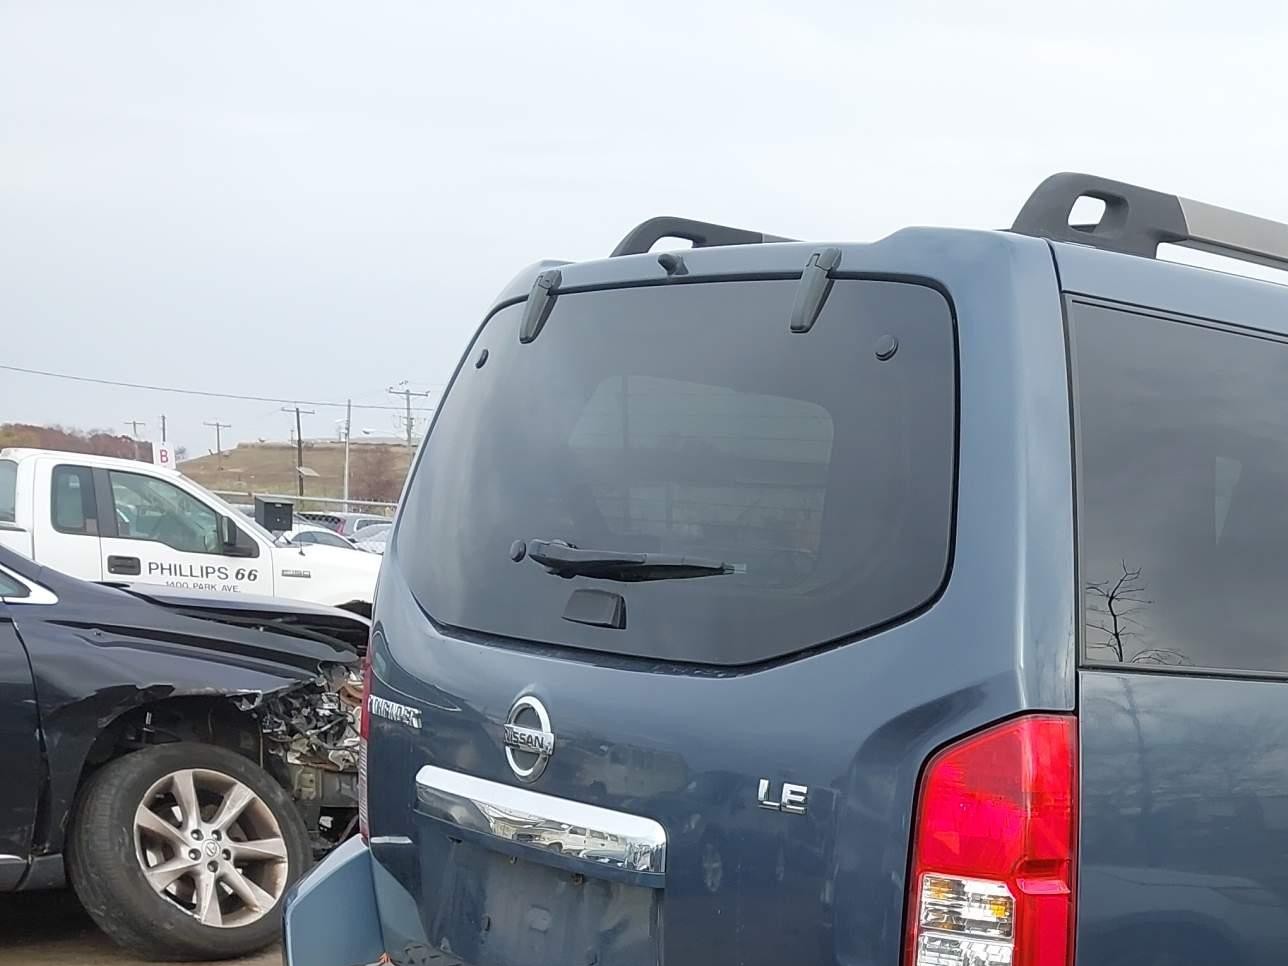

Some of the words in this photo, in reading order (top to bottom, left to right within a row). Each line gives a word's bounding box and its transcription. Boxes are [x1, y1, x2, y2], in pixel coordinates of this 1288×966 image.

[148, 562, 229, 580] PHILLIPS
[235, 568, 258, 581] 66
[193, 582, 218, 591] PARK
[504, 726, 545, 749] NISSAN
[757, 778, 808, 815] LE
